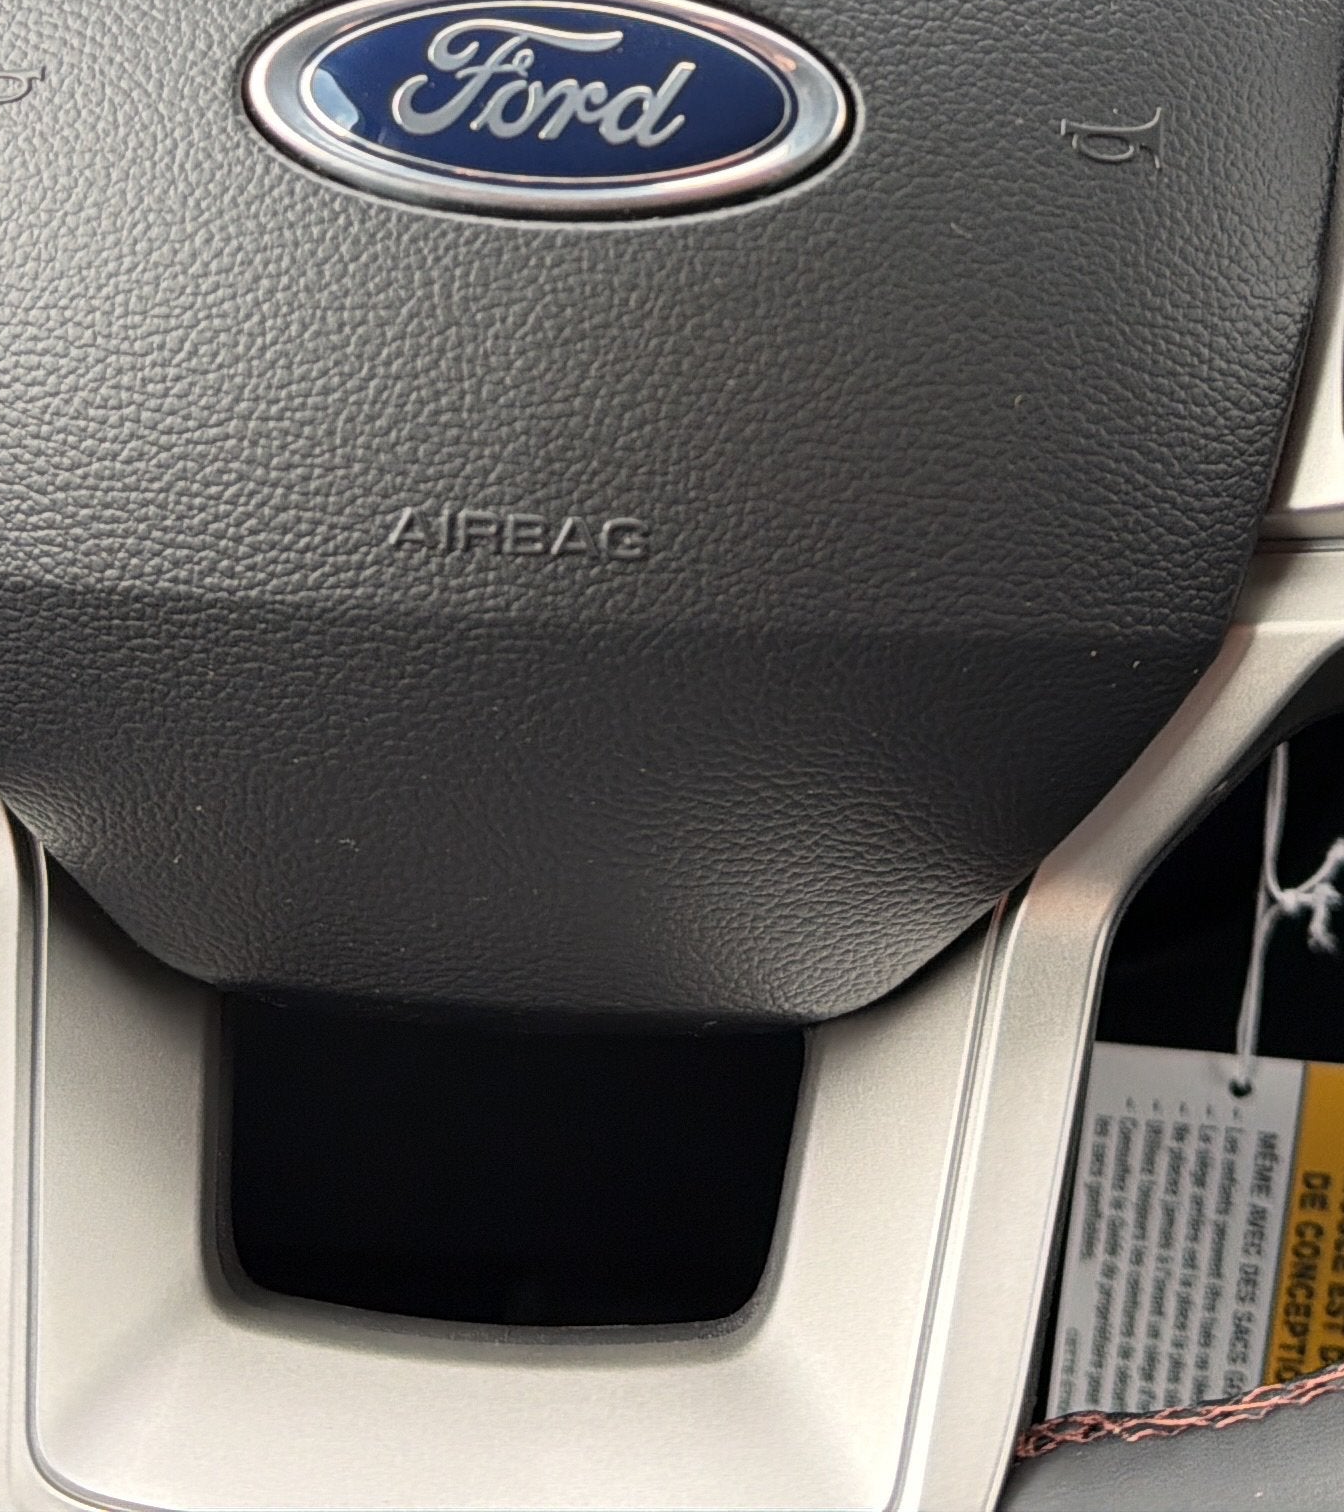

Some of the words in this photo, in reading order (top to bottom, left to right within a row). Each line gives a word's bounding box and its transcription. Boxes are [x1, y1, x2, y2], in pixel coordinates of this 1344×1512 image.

[391, 17, 697, 148] Ford
[387, 505, 652, 561] AIRBAG
[1298, 1170, 1332, 1211] DE
[1275, 1218, 1325, 1383] CONCEPTIO
